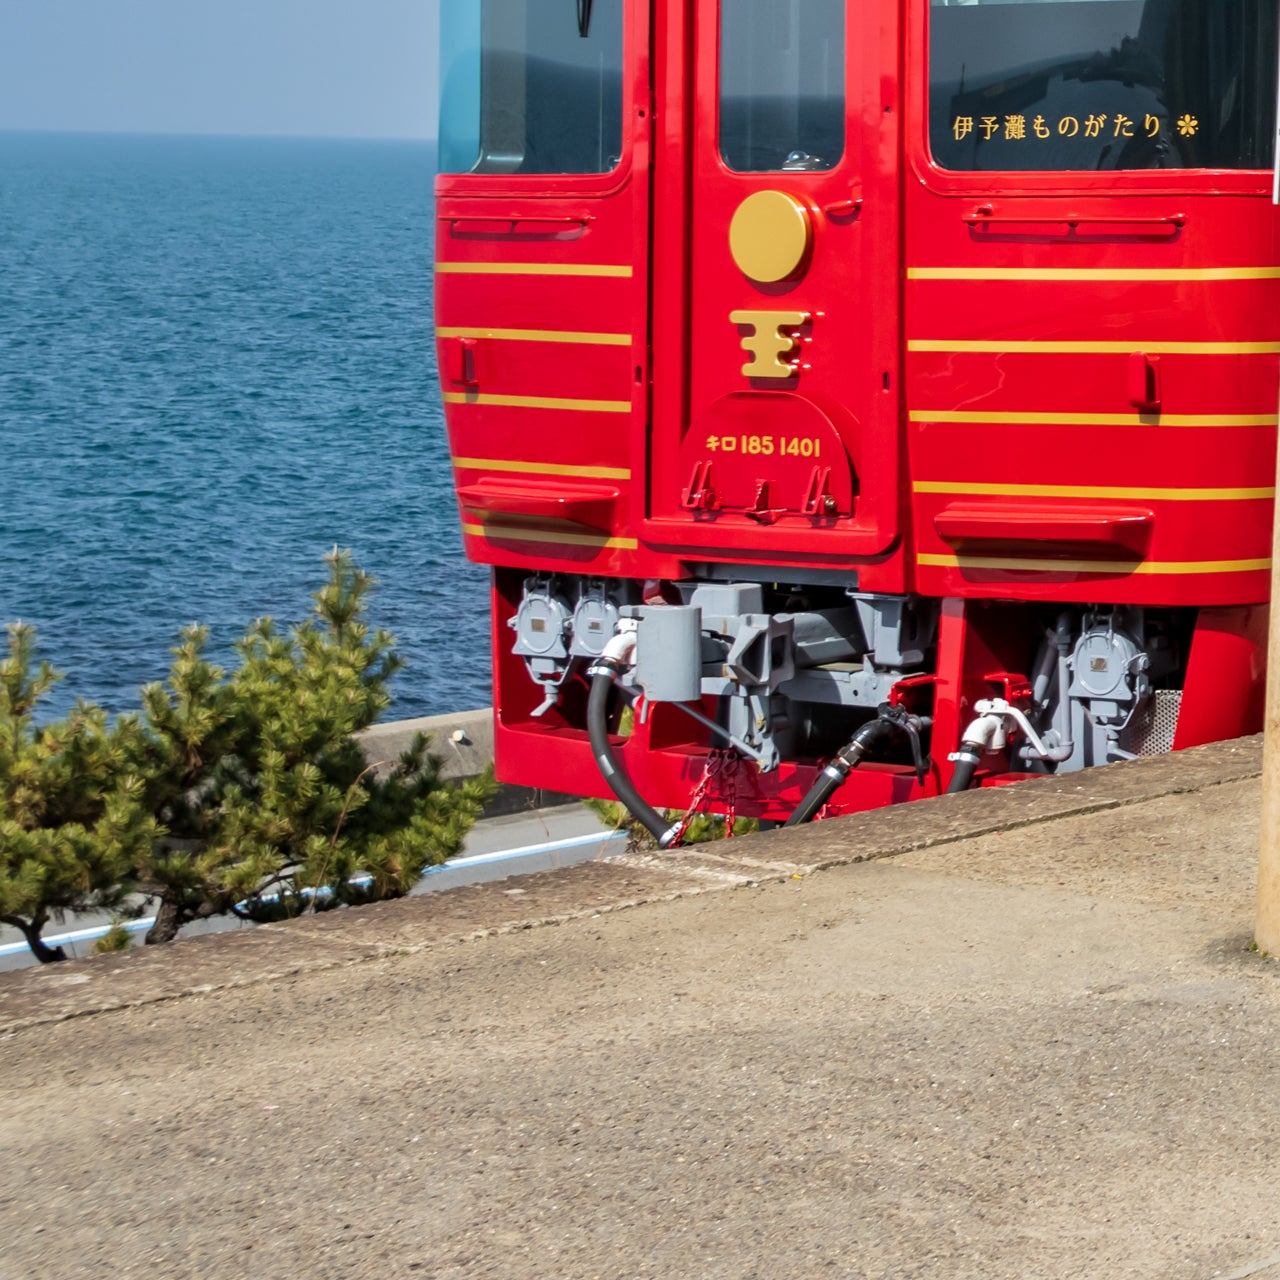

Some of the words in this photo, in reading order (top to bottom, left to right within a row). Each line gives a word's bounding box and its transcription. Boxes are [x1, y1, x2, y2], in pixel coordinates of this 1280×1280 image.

[953, 114, 1160, 140] 伊予灘ものがたり
[780, 437, 820, 457] 1401
